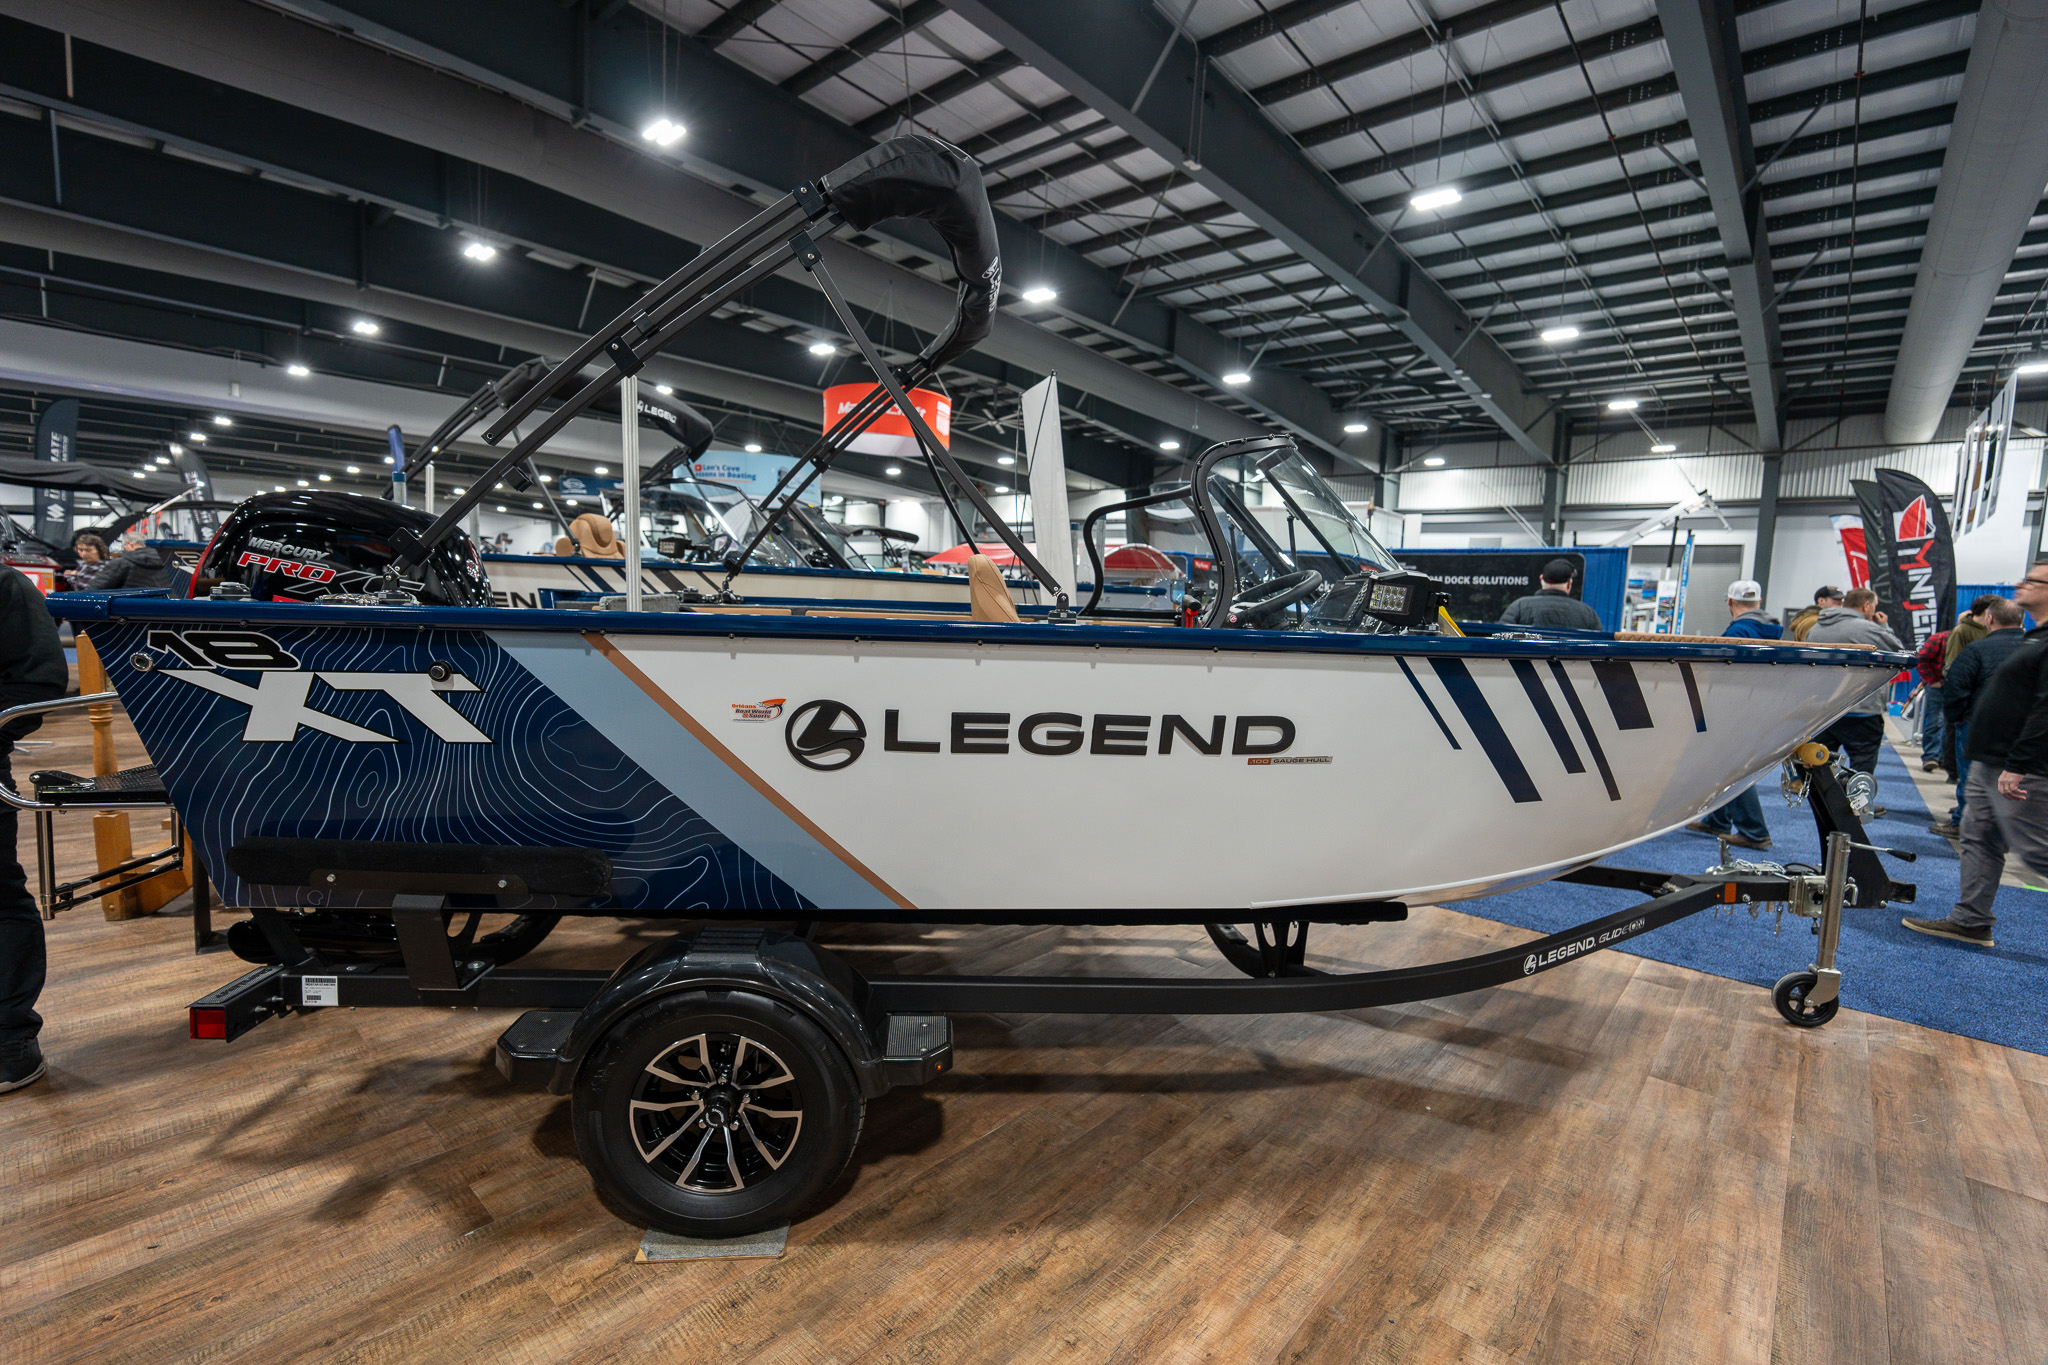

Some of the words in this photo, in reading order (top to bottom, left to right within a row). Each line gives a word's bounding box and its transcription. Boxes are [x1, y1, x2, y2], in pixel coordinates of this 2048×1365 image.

[644, 403, 677, 424] LEGEND
[721, 464, 740, 472] Cove
[727, 472, 756, 481] Boating
[248, 537, 330, 561] MERCURY
[236, 551, 337, 583] PRO
[1444, 576, 1471, 585] DOCK
[1472, 576, 1529, 585] SOLUTIONS
[147, 630, 301, 670] 18
[884, 709, 1296, 756] LEGEND
[1538, 936, 1595, 967] LEGEND
